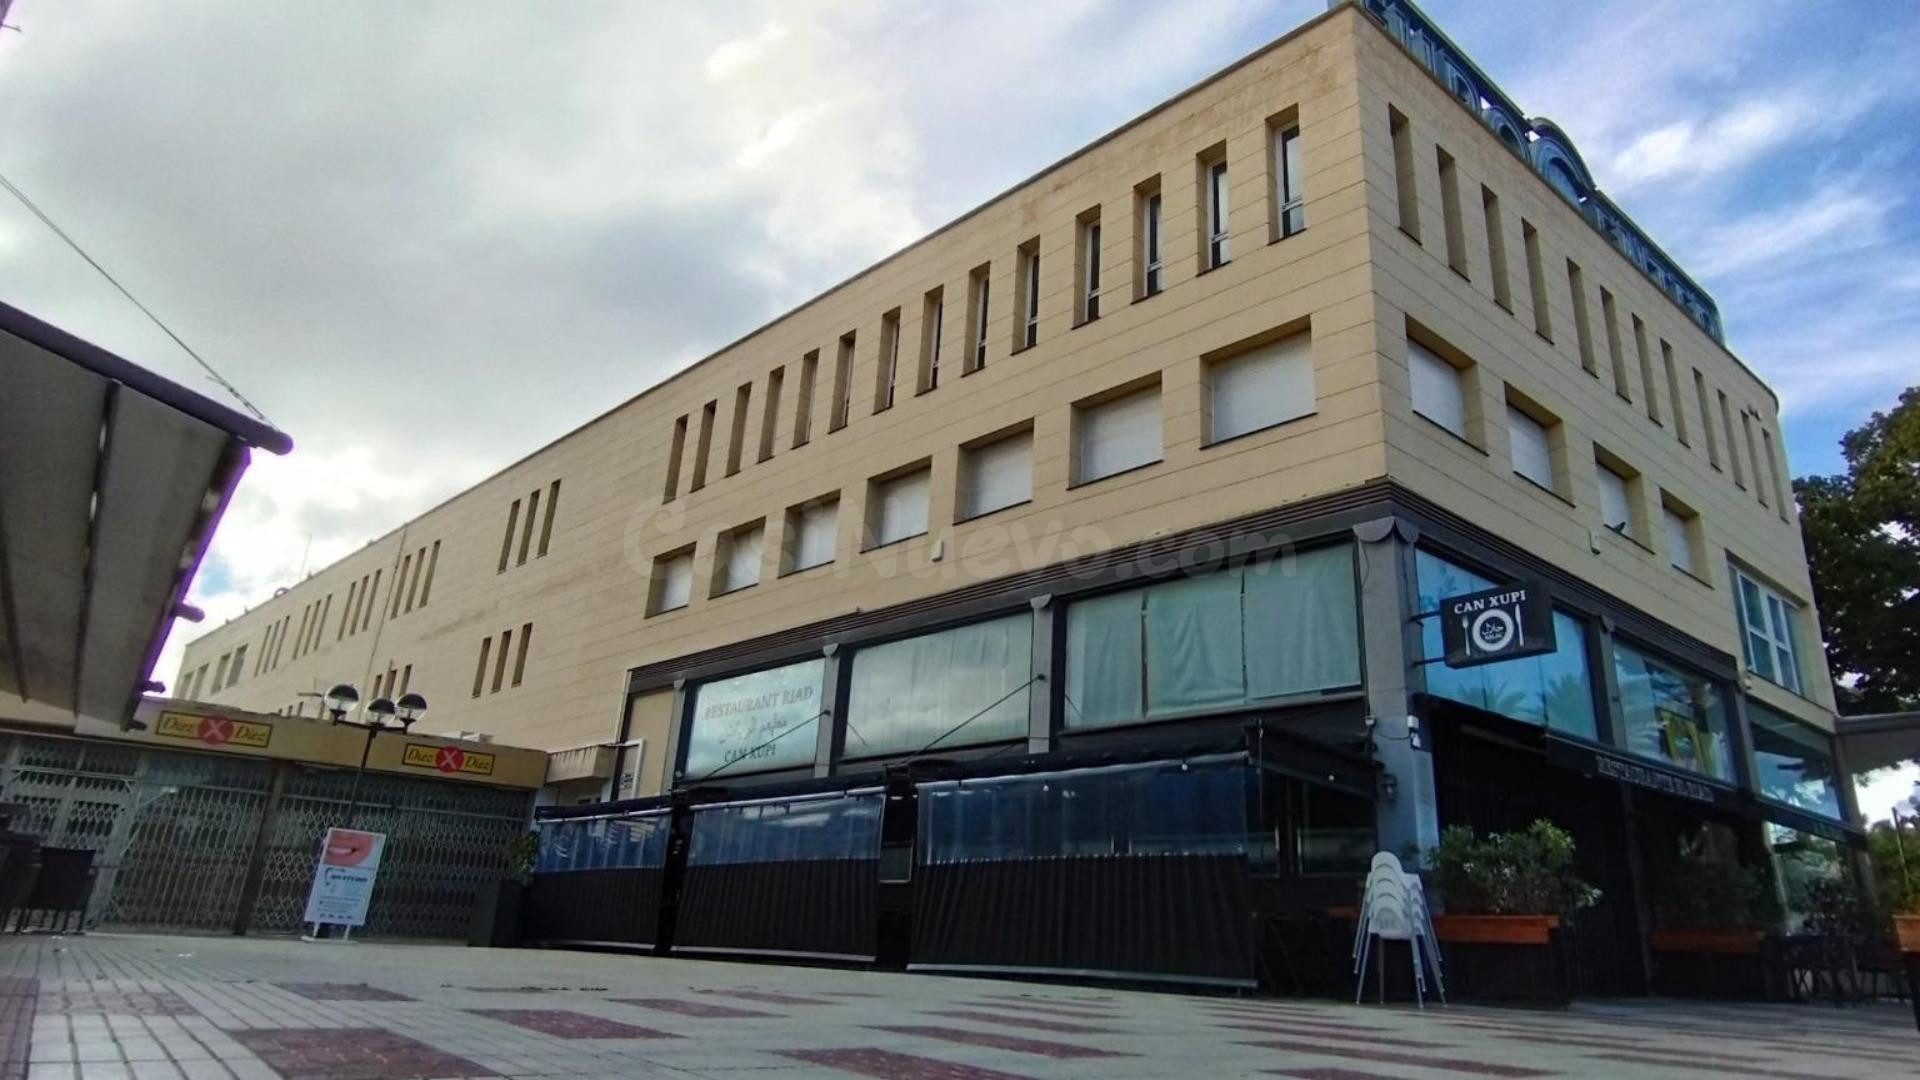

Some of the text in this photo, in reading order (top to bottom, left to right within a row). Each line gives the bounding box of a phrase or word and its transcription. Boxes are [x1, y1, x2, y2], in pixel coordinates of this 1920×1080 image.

[1454, 590, 1526, 615] CAN XUPI
[704, 686, 813, 720] RESTAURANT RIAD
[724, 744, 777, 763] CAN XUPI
